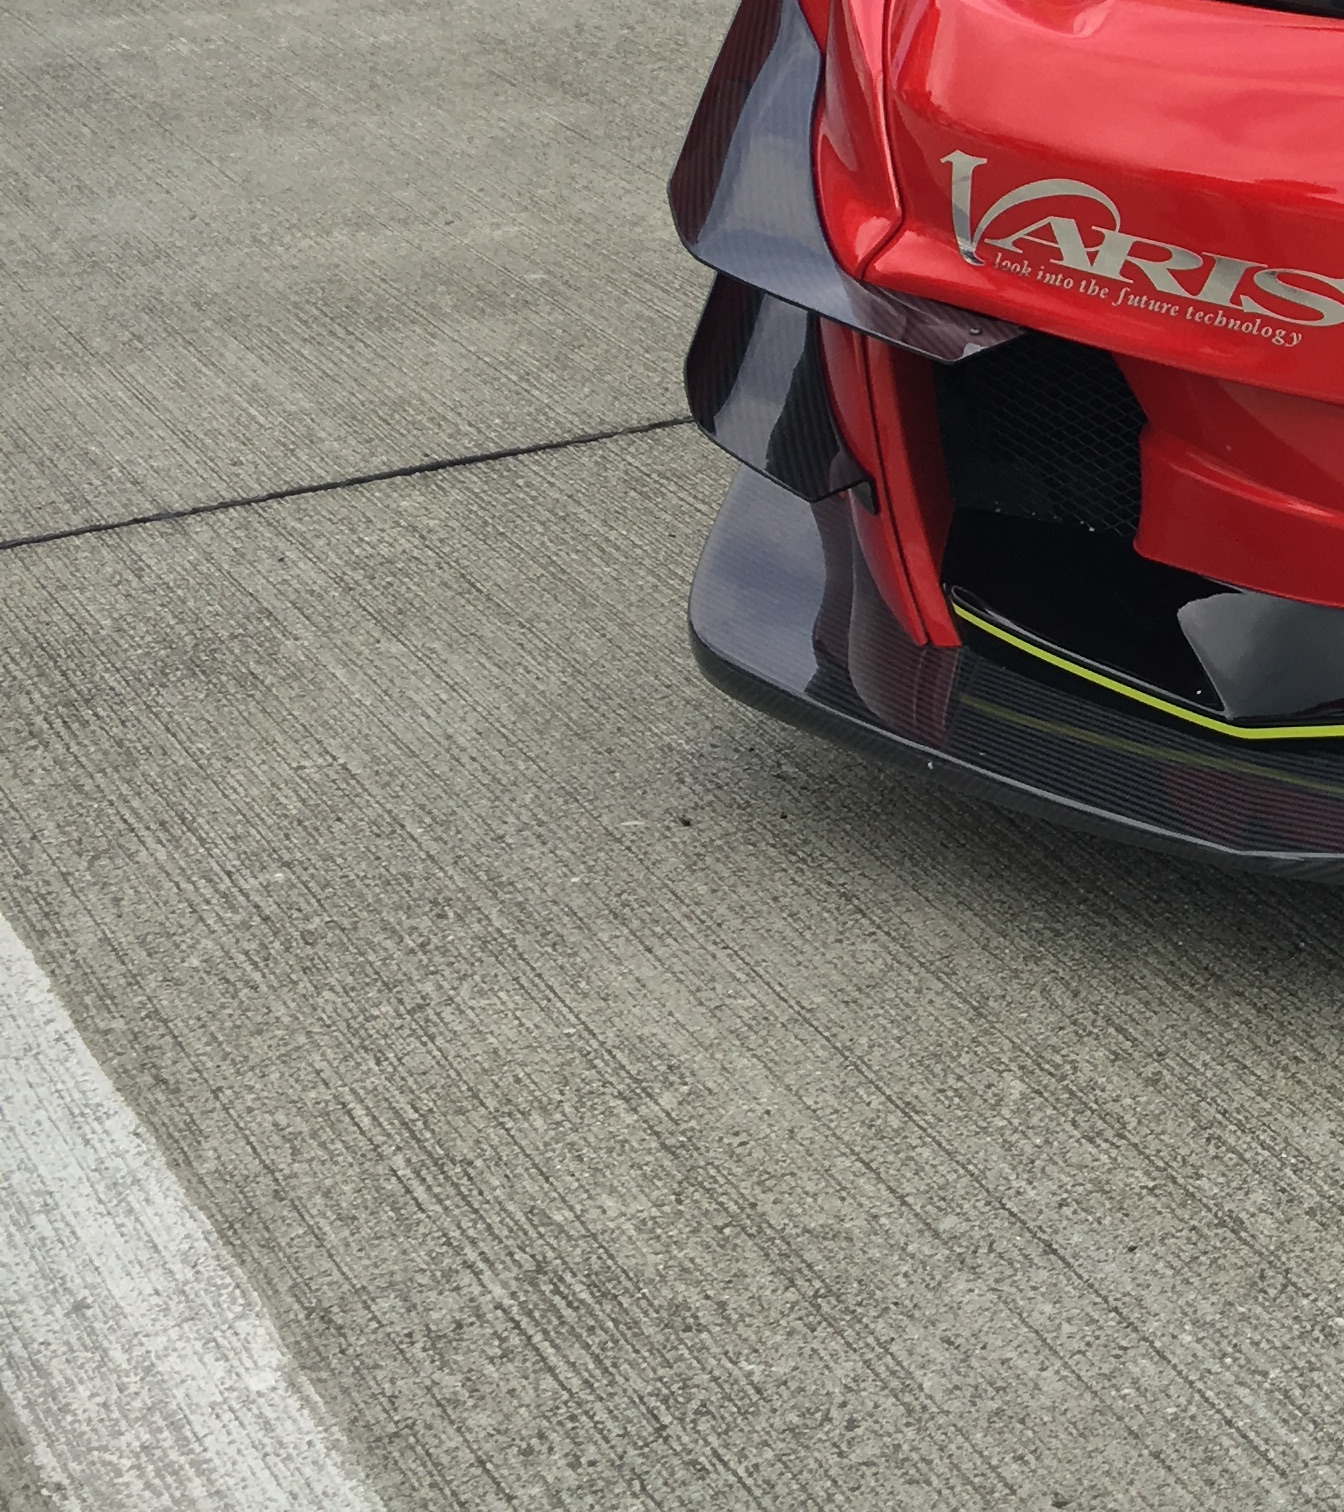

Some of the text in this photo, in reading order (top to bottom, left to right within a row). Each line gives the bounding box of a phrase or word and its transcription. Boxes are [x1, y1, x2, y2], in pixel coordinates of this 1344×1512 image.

[993, 253, 1303, 347] look into the future technology
